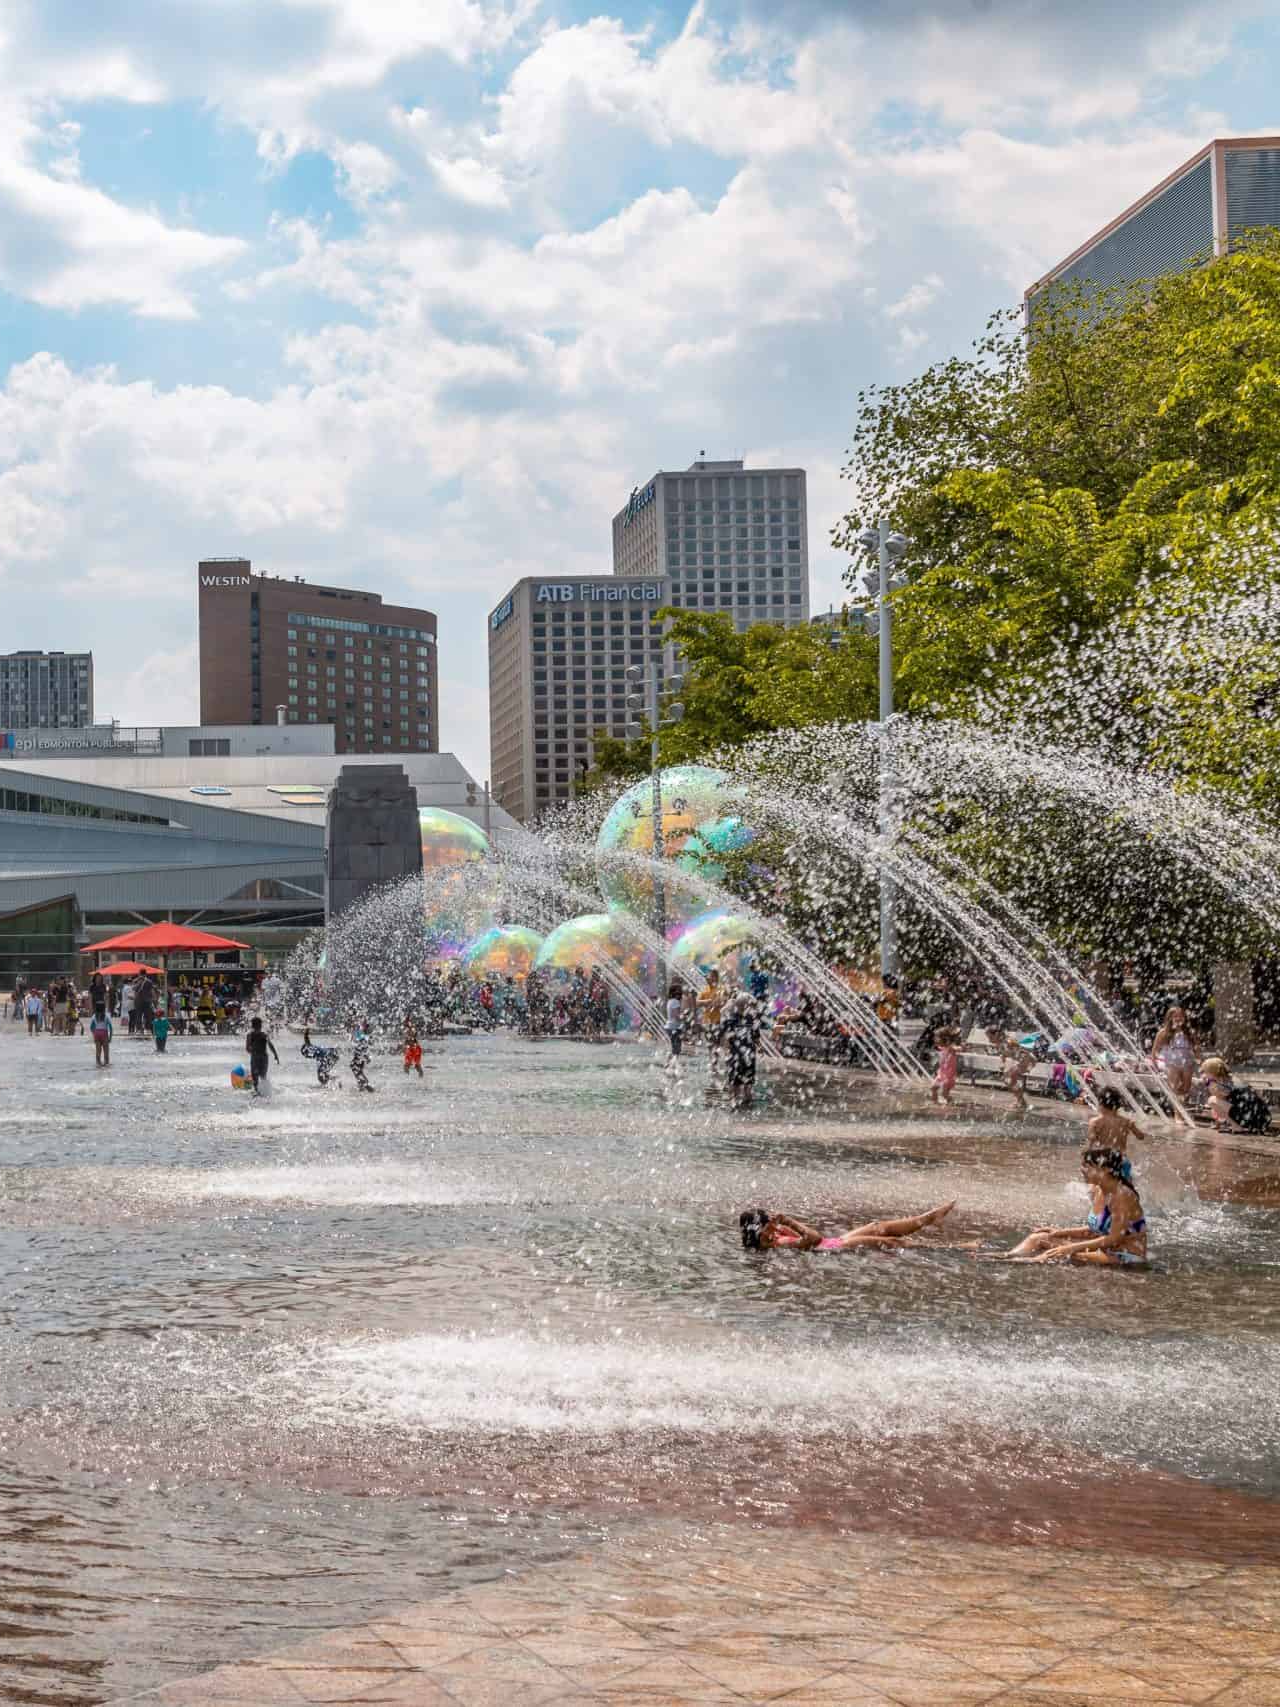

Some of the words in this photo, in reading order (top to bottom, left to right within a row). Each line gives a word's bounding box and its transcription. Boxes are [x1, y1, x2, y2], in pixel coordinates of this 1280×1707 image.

[537, 584, 573, 602] ATB
[580, 582, 662, 601] Financial
[15, 735, 36, 752] epl
